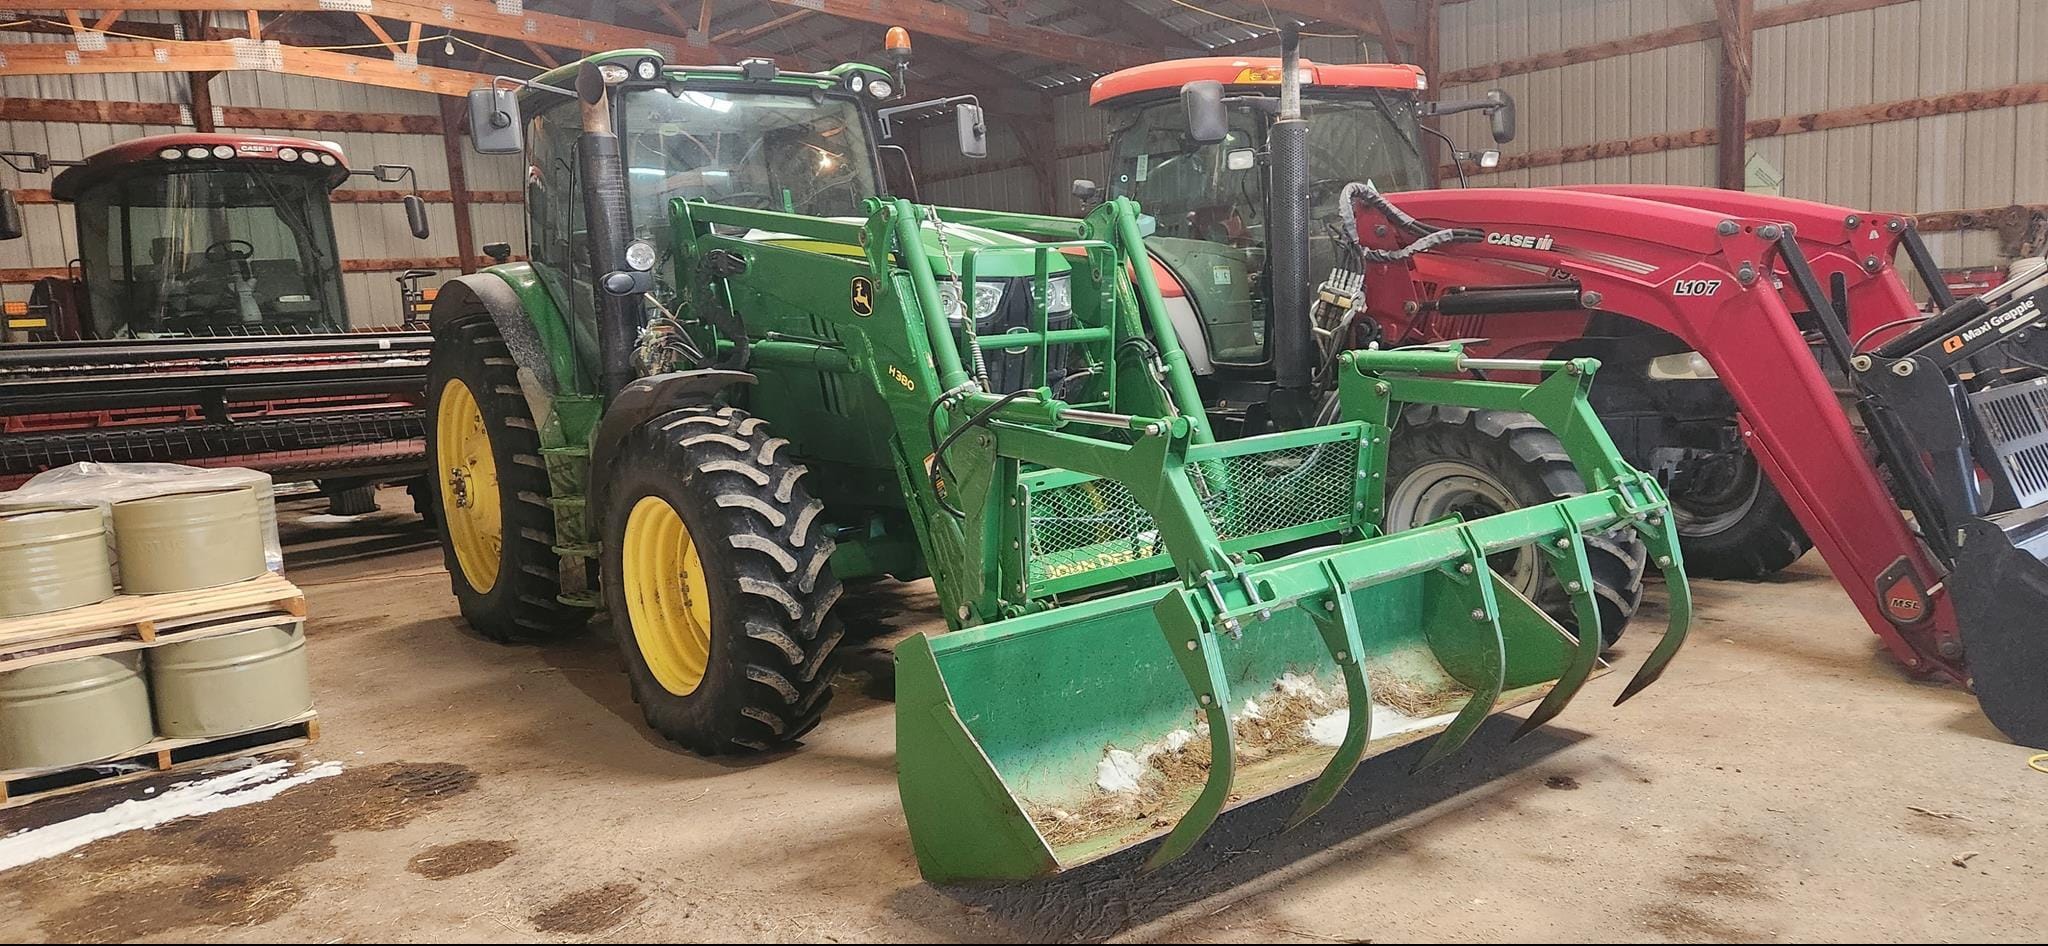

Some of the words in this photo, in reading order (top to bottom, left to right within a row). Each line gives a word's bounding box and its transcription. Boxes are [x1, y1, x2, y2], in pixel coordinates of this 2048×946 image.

[1487, 232, 1537, 249] CASE
[1673, 280, 1722, 296] L107
[1961, 321, 1992, 342] Maxi
[1990, 299, 2035, 327] Grapple
[888, 364, 915, 391] H380
[1891, 597, 1921, 610] MSL
